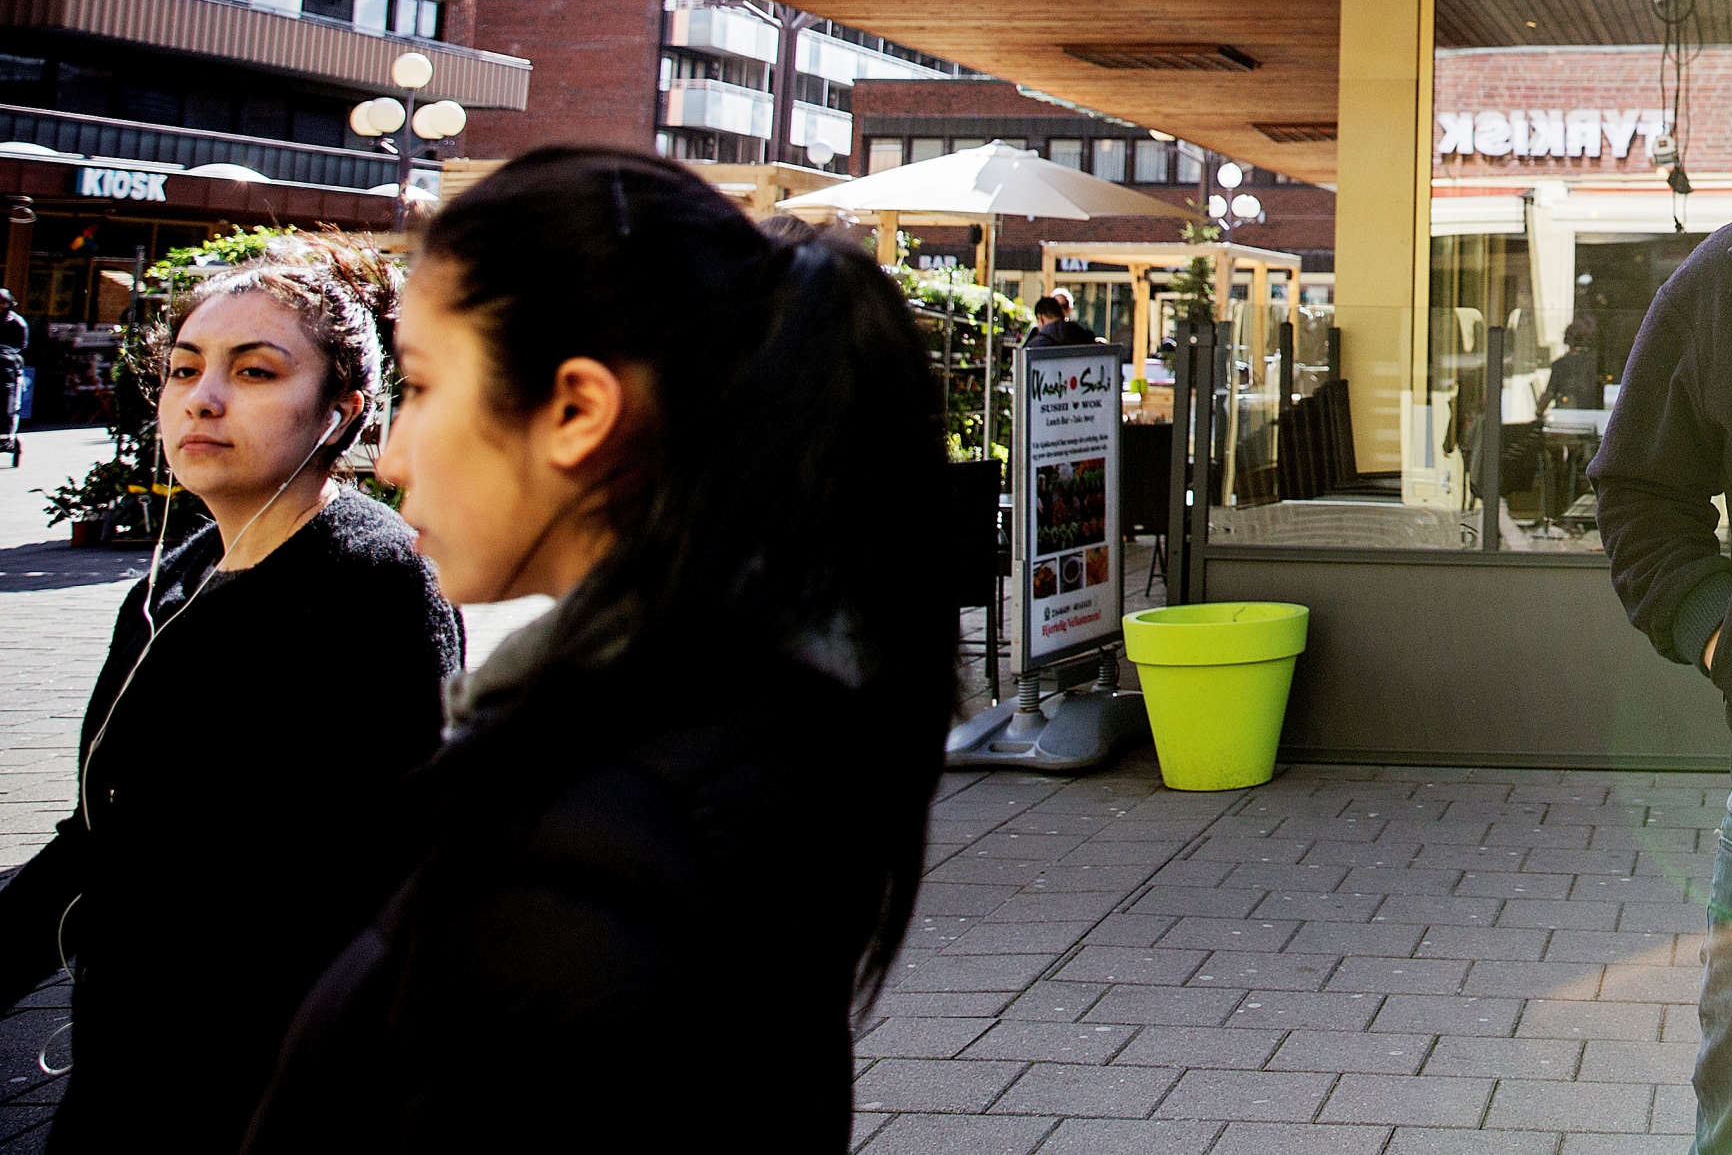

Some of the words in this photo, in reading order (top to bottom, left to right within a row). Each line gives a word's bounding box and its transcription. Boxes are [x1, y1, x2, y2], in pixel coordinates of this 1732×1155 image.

[79, 167, 168, 202] KIOSK
[918, 254, 958, 270] BAR
[1032, 368, 1068, 401] Wasabi
[1079, 363, 1111, 395] Sushi
[1040, 402, 1069, 414] SUSHI
[1081, 399, 1103, 409] WOK
